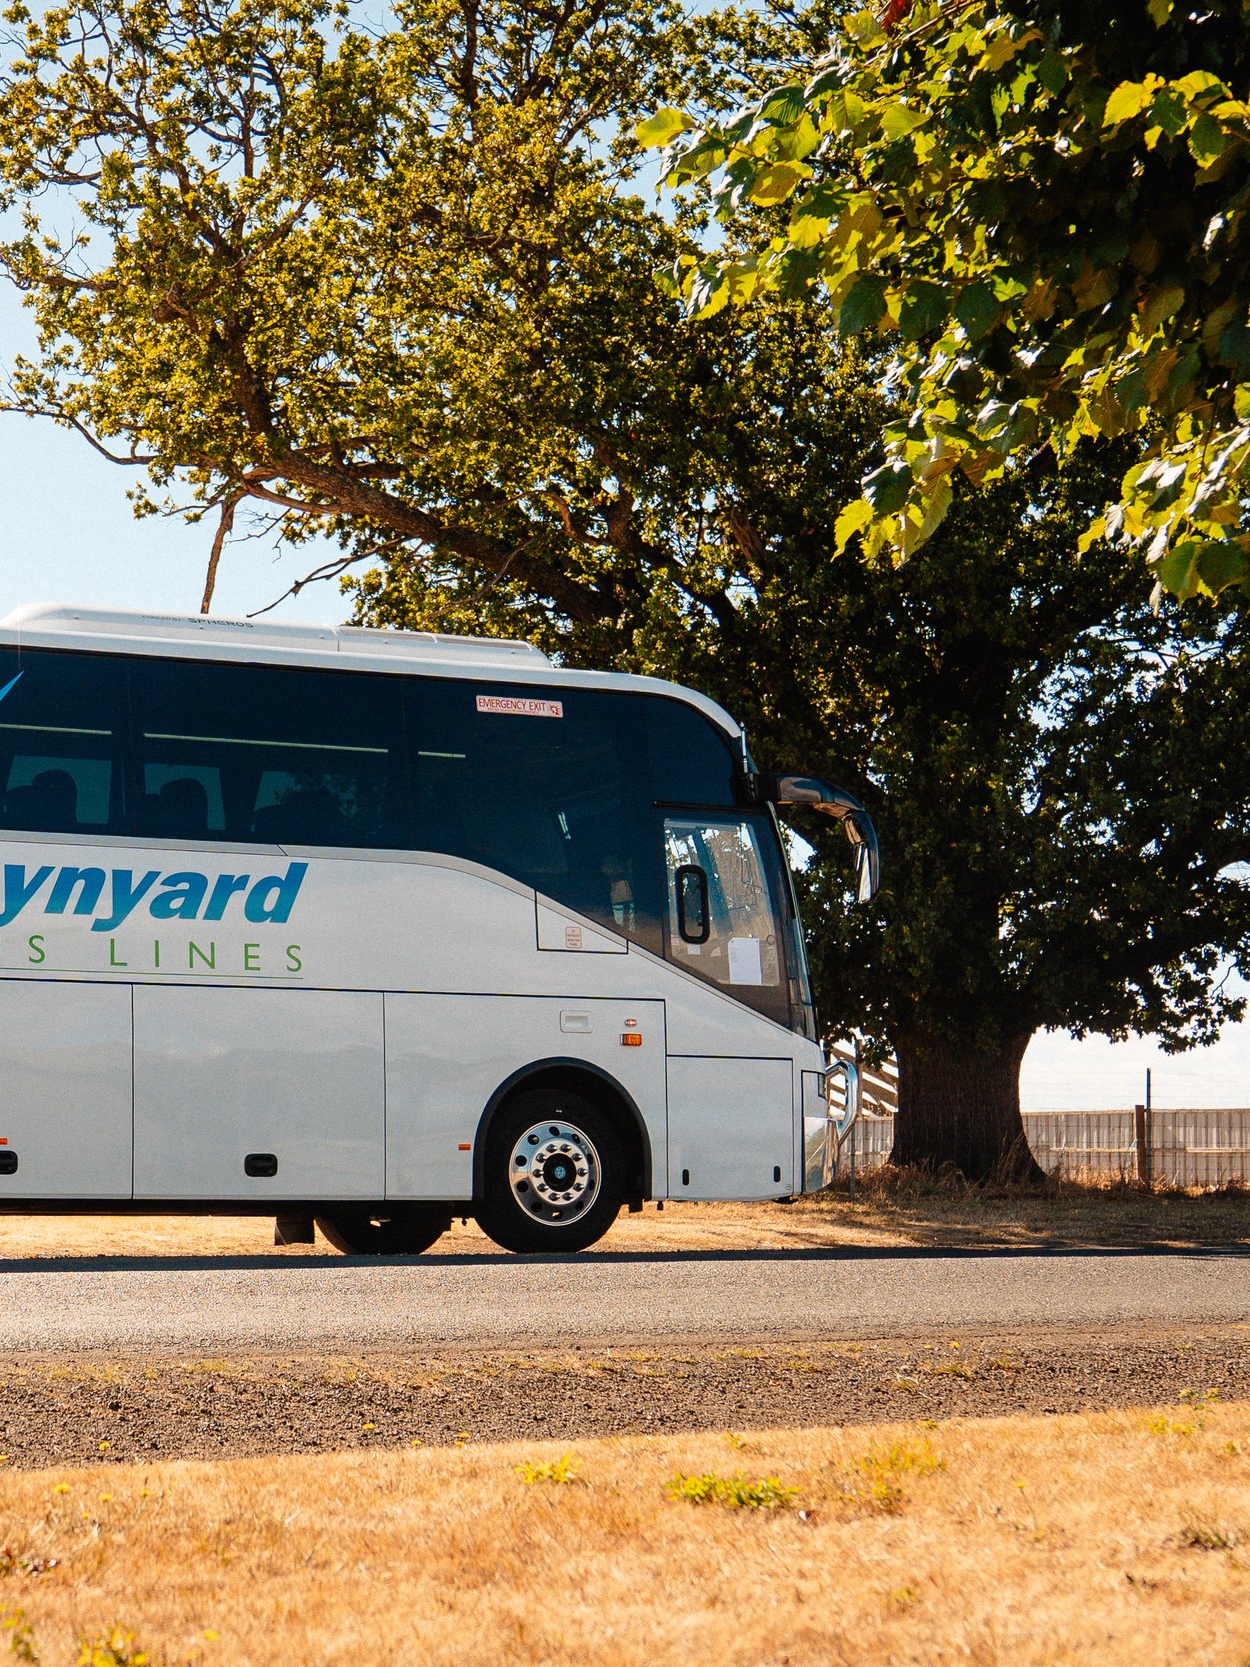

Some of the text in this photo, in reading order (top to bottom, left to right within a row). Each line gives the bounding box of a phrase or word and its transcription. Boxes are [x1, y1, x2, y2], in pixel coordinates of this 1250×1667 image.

[188, 617, 254, 628] SPHEROS
[478, 697, 527, 710] EMERGENCY
[529, 701, 546, 712] EXIT
[109, 938, 303, 973] LINES
